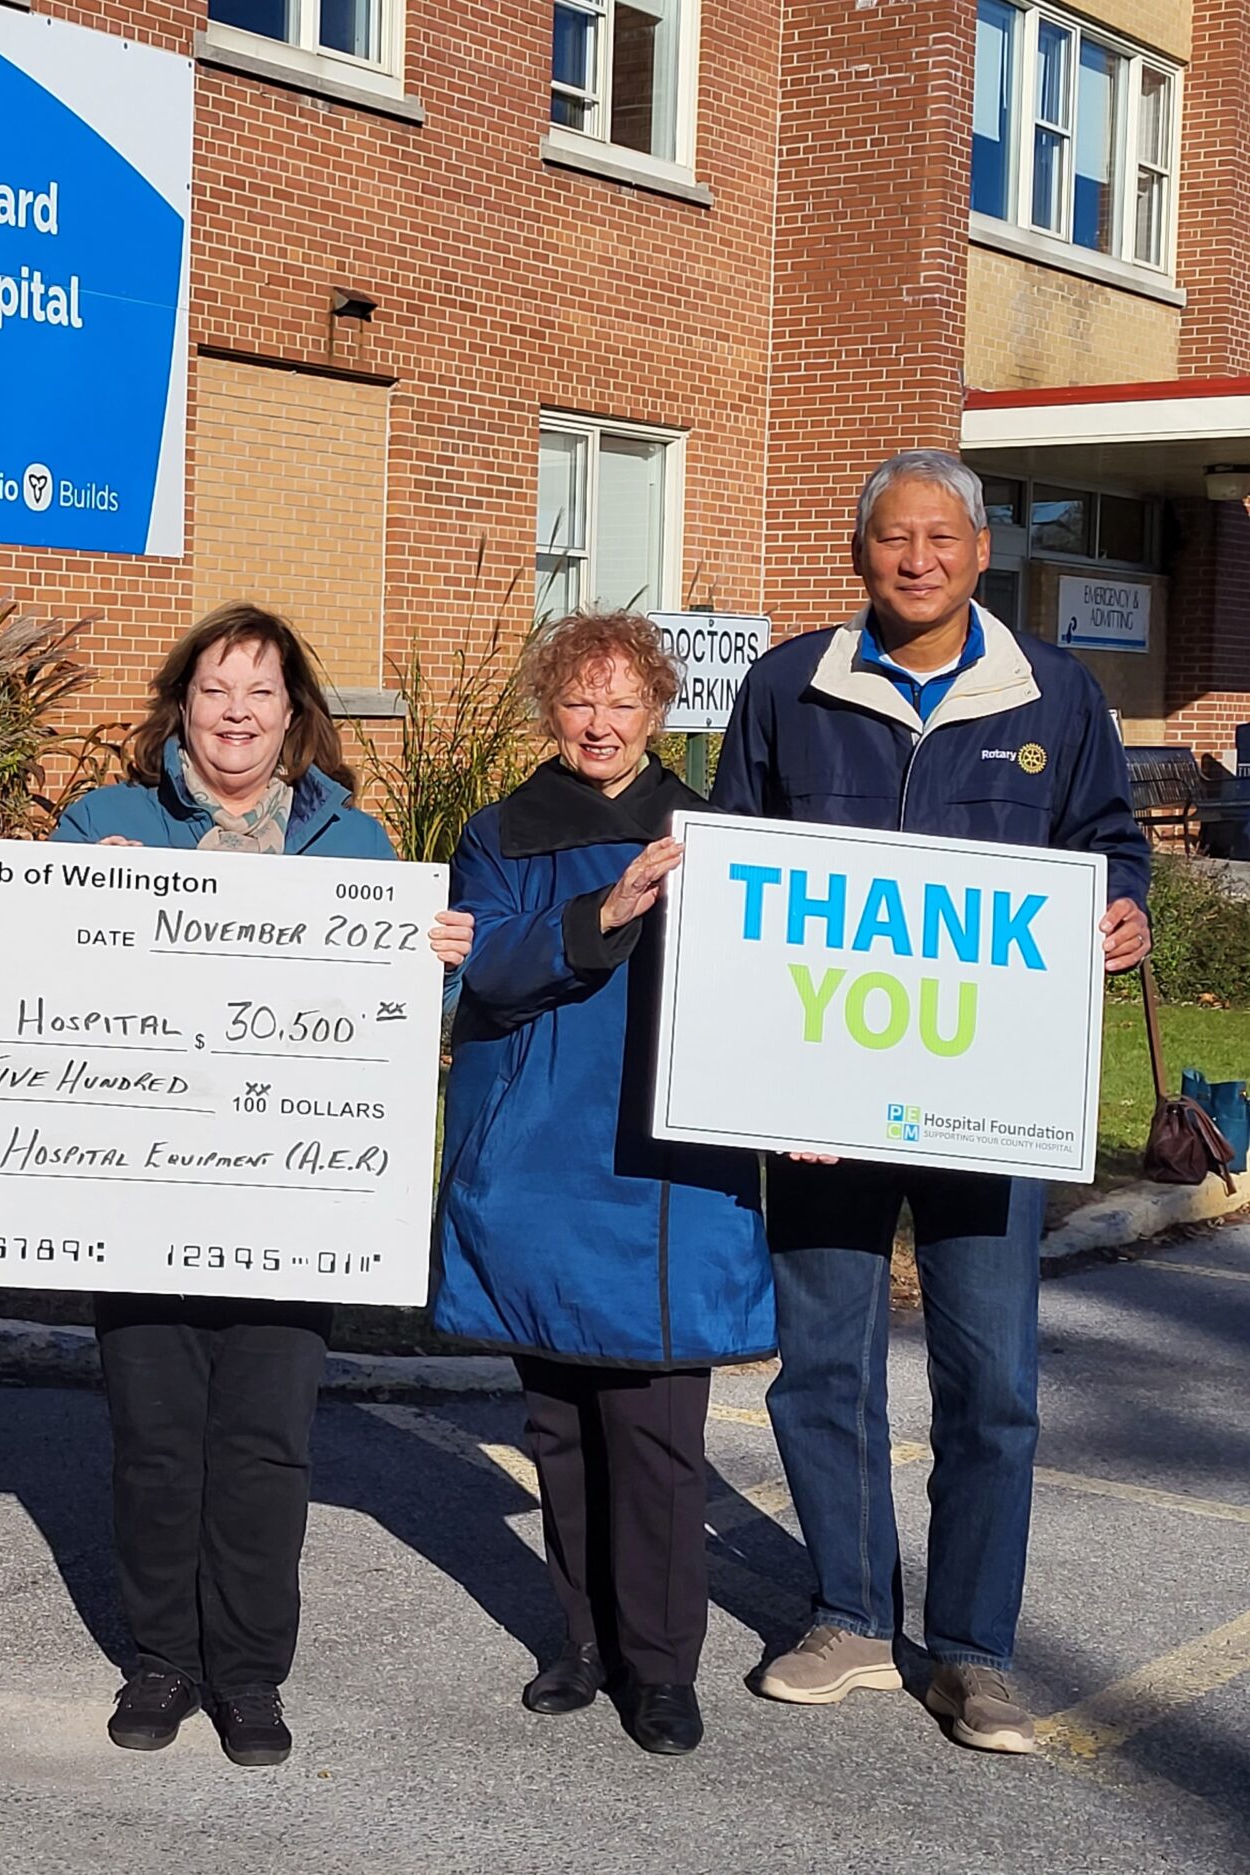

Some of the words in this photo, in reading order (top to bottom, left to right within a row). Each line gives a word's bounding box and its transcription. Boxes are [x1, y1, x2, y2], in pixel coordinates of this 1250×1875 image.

[59, 481, 119, 512] Builds
[1084, 585, 1129, 608] EMERGENCY
[1091, 608, 1134, 630] ADMITTING
[661, 628, 758, 664] DOCTORS
[676, 677, 738, 710] ARKIN
[981, 749, 1017, 762] Rotary
[24, 864, 53, 885] of
[62, 865, 218, 896] Wellington
[335, 883, 395, 902] 00001
[729, 863, 1049, 971] THANK
[77, 929, 135, 947] DATE
[323, 915, 420, 952] 2022
[787, 963, 979, 1058] YOU
[195, 1033, 205, 1049] $
[233, 1097, 266, 1113] 100
[281, 1099, 385, 1119] DOLLARS
[924, 1113, 985, 1132] Hospital
[990, 1120, 1075, 1141] Foundation
[923, 1130, 975, 1143] SUPPORTING
[976, 1136, 999, 1145] YOUR
[1001, 1138, 1035, 1149] COUNTY
[1035, 1142, 1073, 1153] HOSPITAL
